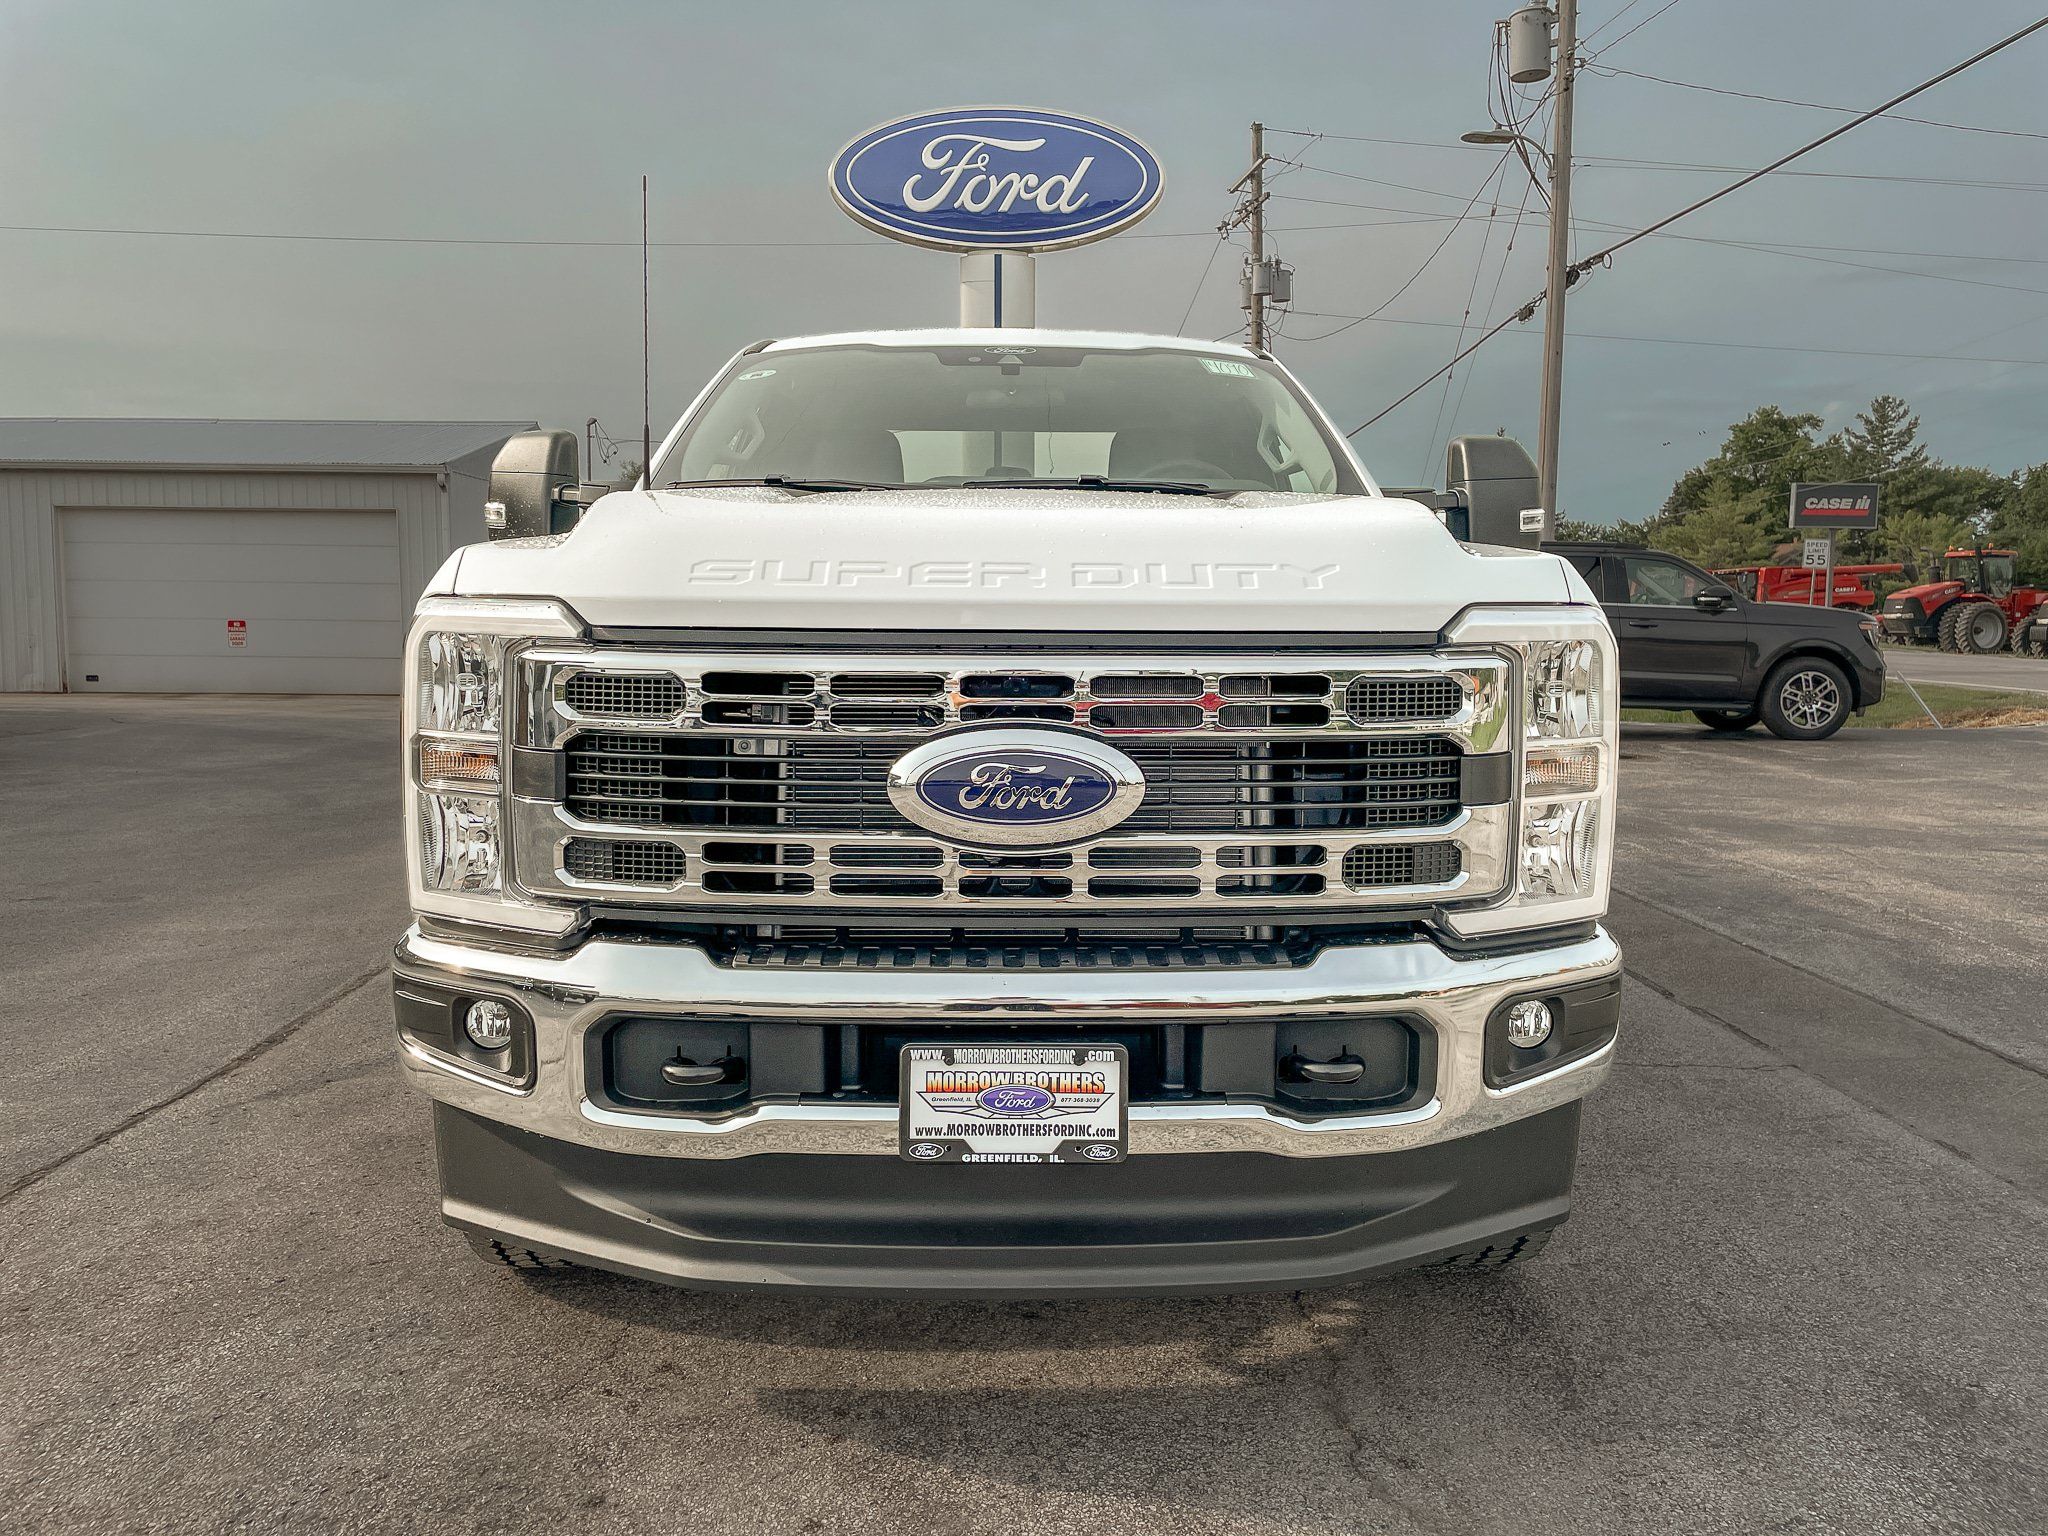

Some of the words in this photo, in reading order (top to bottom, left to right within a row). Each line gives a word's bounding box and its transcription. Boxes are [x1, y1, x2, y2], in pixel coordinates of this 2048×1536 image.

[903, 133, 1095, 214] Ford
[1805, 497, 1853, 510] CASE
[1805, 554, 1826, 565] 55
[688, 559, 1047, 590] SUPER
[1071, 562, 1341, 591] DUTY
[958, 762, 1076, 810] Ford
[910, 1050, 945, 1061] www.
[954, 1049, 1076, 1065] MORROWBROTHERSFORDINC
[1084, 1050, 1115, 1062] .com
[926, 1071, 1012, 1093] MORROW
[1011, 1071, 1105, 1093] BROTHERS
[995, 1091, 1036, 1109] Ford
[915, 1123, 1116, 1138] www.MORROWBROTHERSFORDINC.com
[915, 1144, 938, 1157] Ford
[1090, 1145, 1112, 1158] Ford
[962, 1153, 1043, 1164] GREENFIELD,
